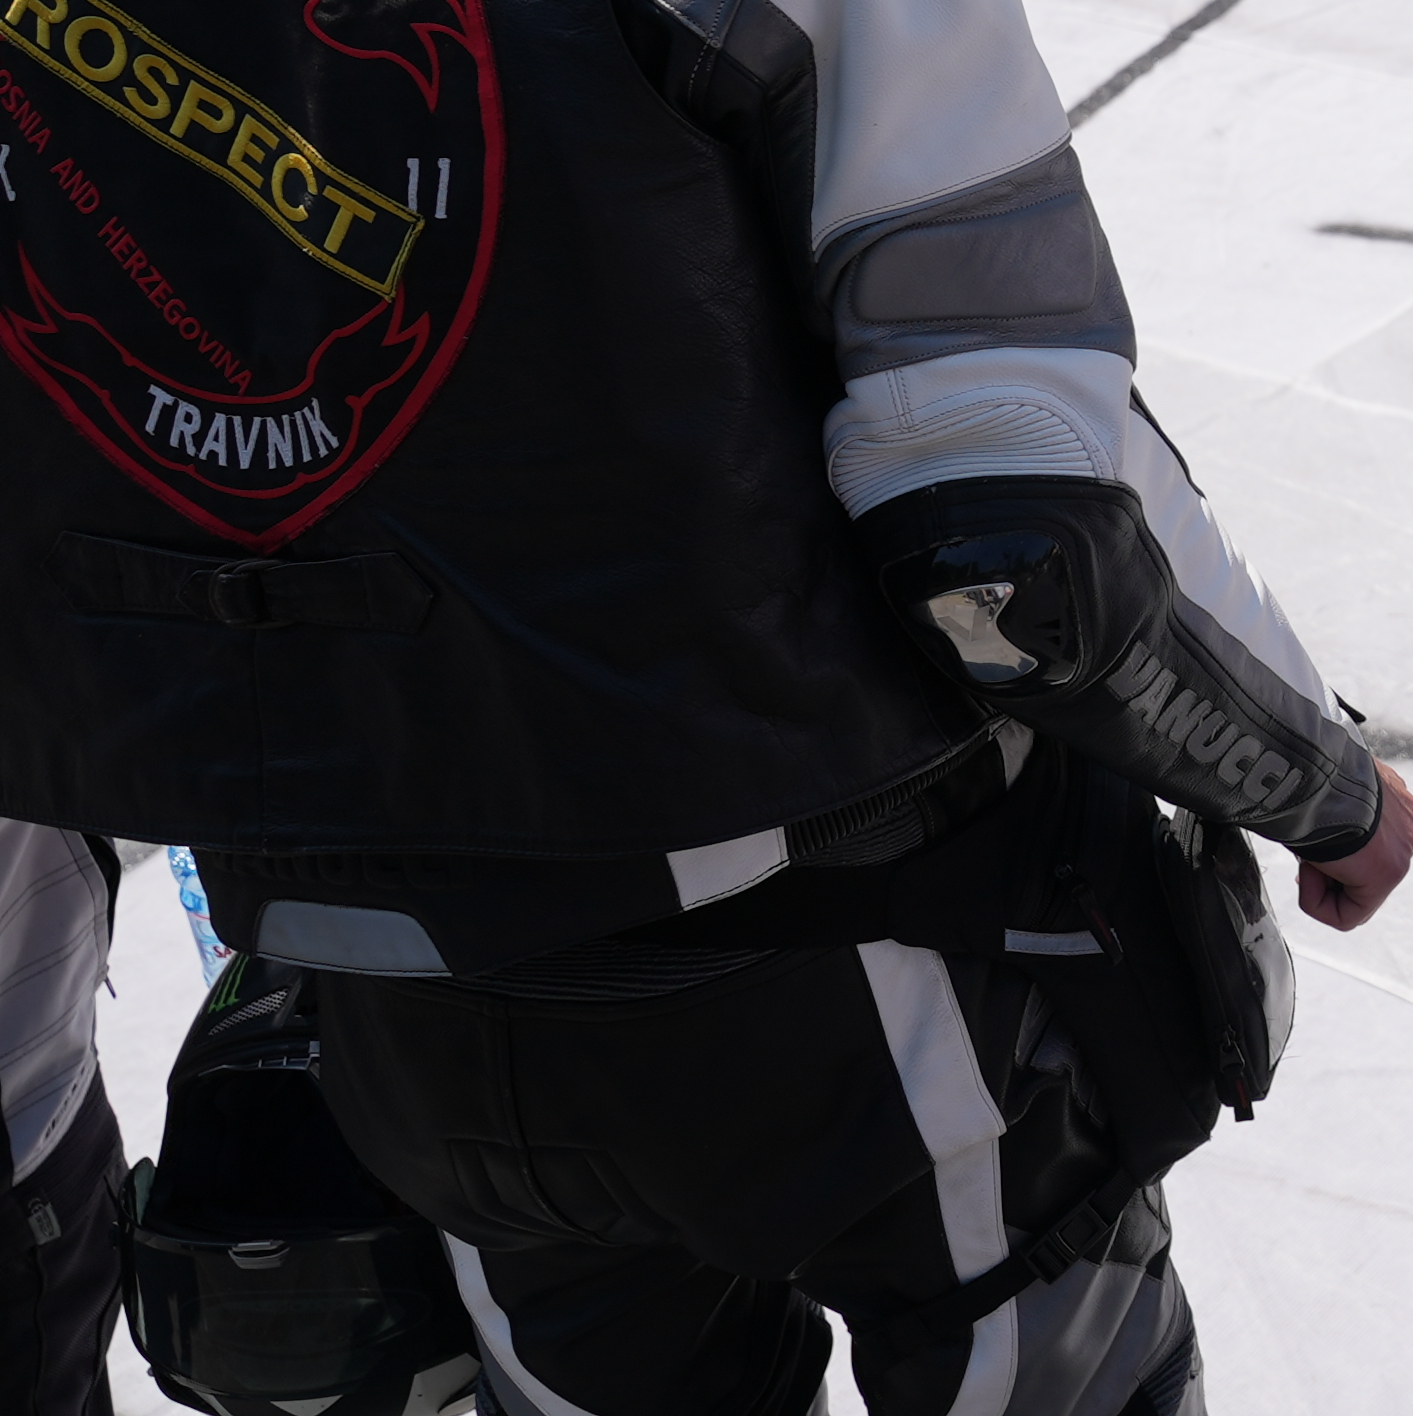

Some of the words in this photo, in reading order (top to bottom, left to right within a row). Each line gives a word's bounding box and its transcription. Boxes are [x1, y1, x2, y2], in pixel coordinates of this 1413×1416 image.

[0, 69, 52, 154] OSNIA
[50, 157, 101, 215] AND
[97, 215, 253, 396] HERZEGOVINA
[144, 384, 340, 470] TRAVNIK
[1105, 639, 1304, 812] VANUCCI
